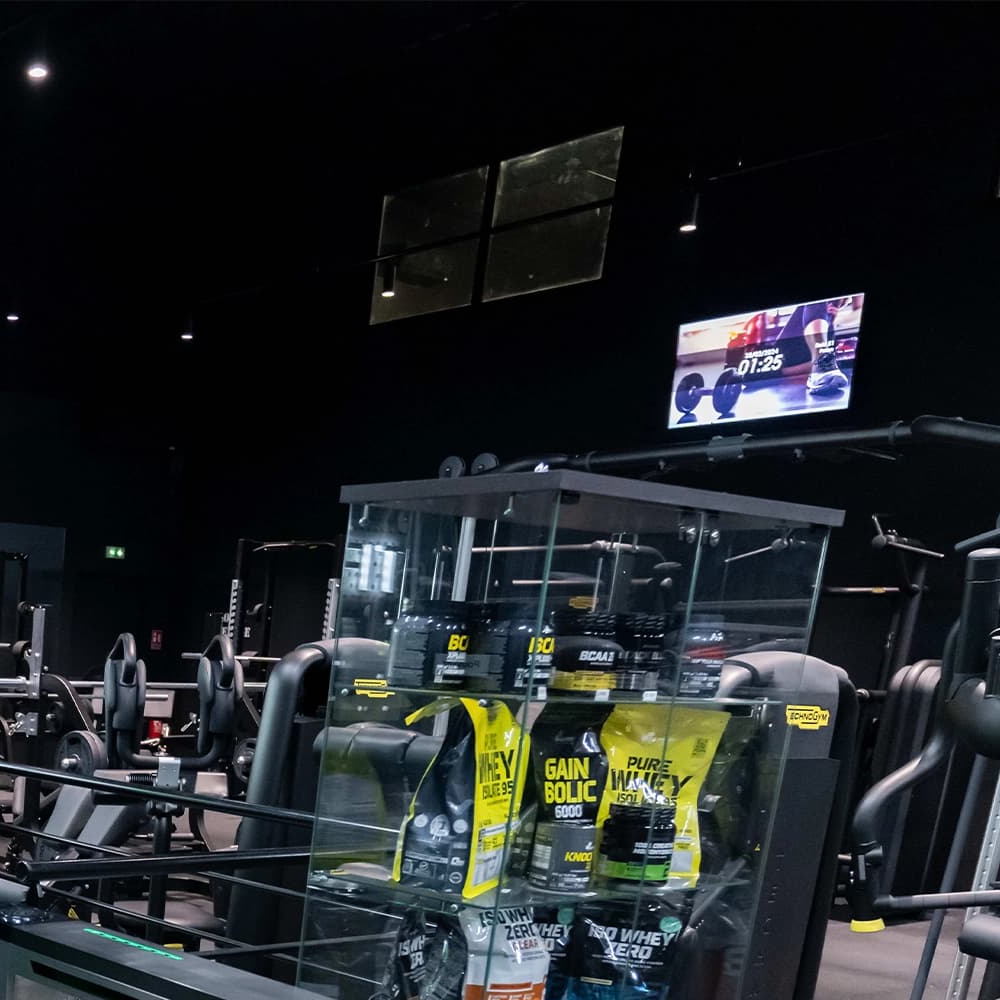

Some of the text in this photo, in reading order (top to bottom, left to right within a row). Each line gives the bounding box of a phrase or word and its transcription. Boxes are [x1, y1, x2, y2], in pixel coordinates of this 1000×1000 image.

[738, 354, 783, 374] 01:25
[479, 749, 514, 784] WHEY
[545, 757, 590, 780] GAIN
[627, 756, 673, 773] PURE
[611, 768, 694, 796] WHEY
[544, 780, 597, 804] BOLIC
[554, 804, 583, 818] 6000
[505, 907, 534, 923] WH
[620, 928, 675, 946] WHEY
[604, 941, 653, 959] ZERO
